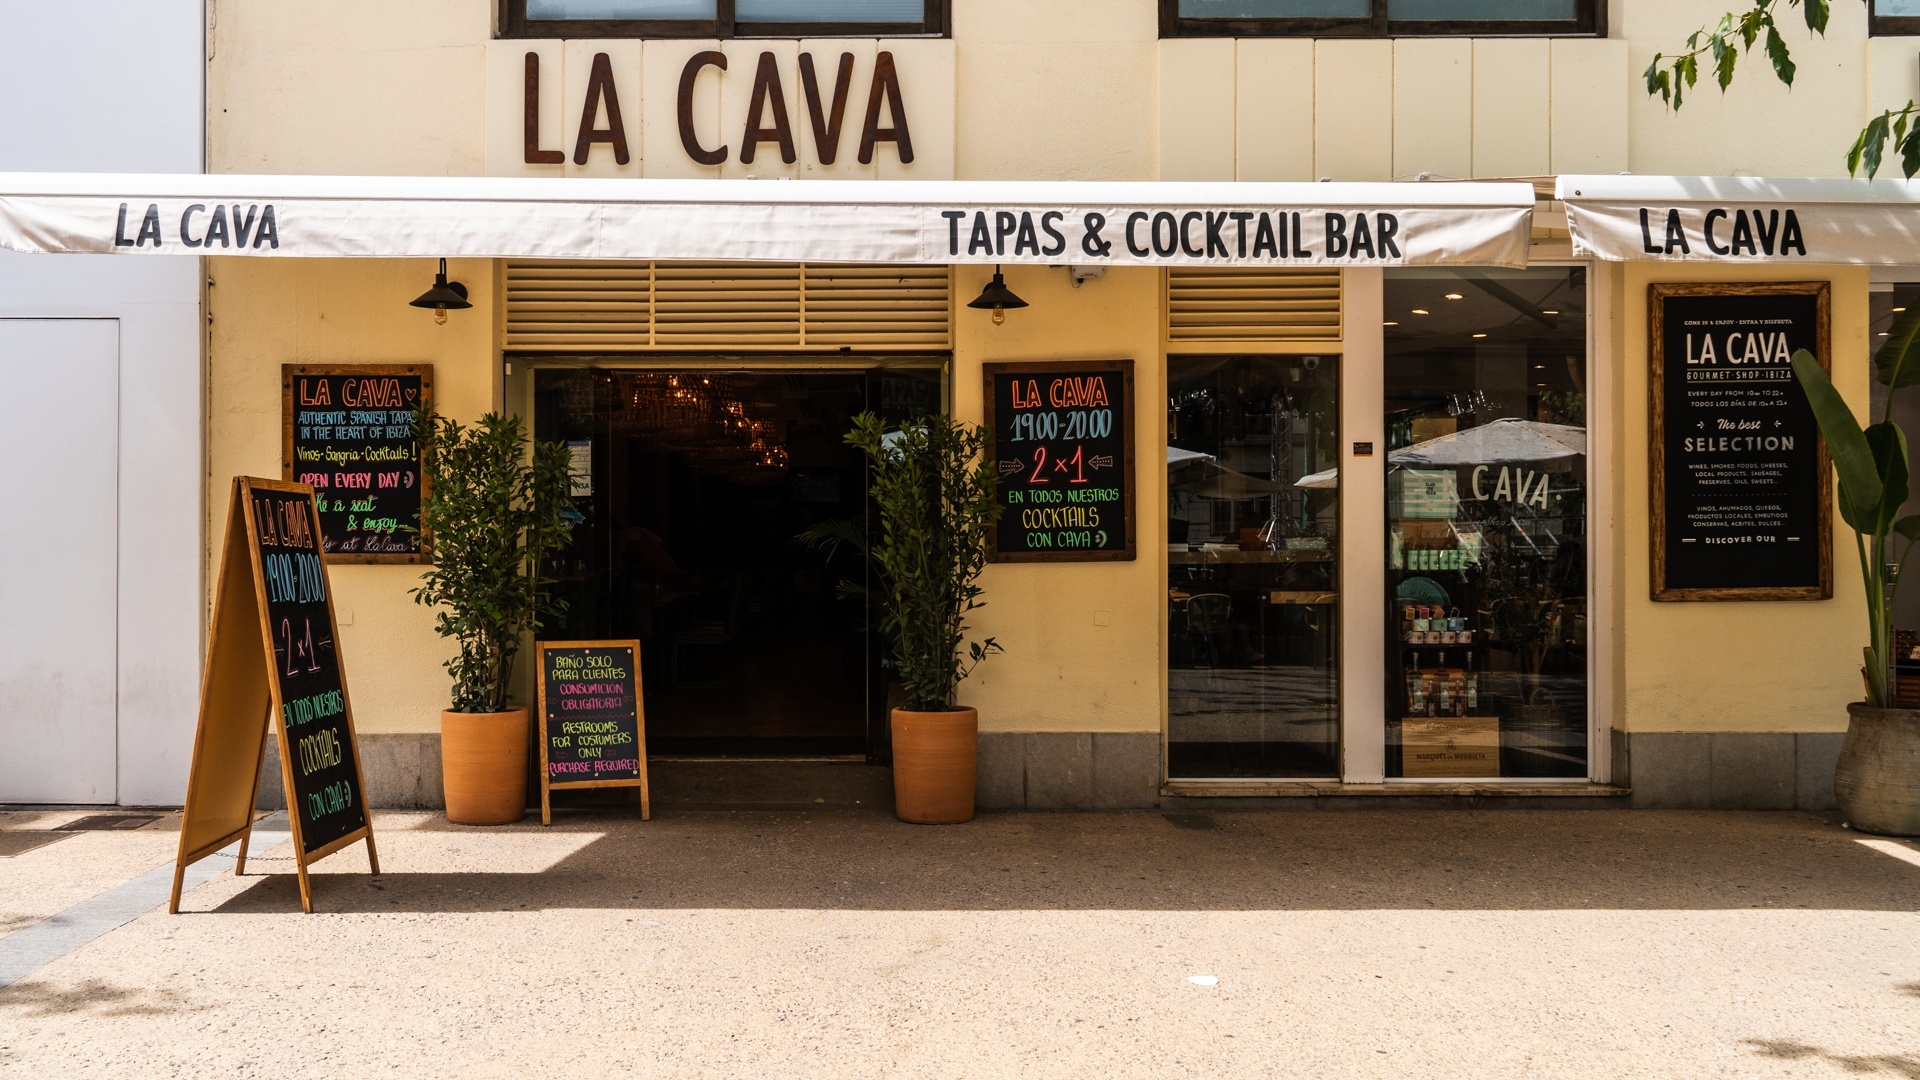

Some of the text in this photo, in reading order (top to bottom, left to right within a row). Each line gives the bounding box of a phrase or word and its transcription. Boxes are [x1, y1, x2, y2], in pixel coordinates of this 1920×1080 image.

[524, 50, 914, 165] LA CAVA
[115, 203, 279, 249] LA CAVA
[1639, 208, 1806, 256] LA CAVA
[941, 210, 1401, 259] TAPAS & COCKTAIL BAR
[1686, 332, 1791, 364] LA CAVA
[300, 378, 403, 407] LA CAVA
[1012, 377, 1108, 408] LA CAVA
[298, 411, 346, 425] AUTHENTIC
[350, 410, 387, 425] SPANISH
[1717, 419, 1761, 430] The best
[301, 426, 411, 440] IN THE HEART OF IBIZA
[1684, 436, 1794, 452] SELECTION
[300, 472, 399, 489] OPEN EVERY DAY
[1472, 465, 1549, 509] CAVA
[333, 500, 345, 512] a
[350, 495, 378, 512] seat
[1008, 488, 1119, 503] EN TODOS NUESTROS
[256, 499, 313, 548] LA CAVA
[347, 515, 357, 531] &
[1022, 506, 1099, 529] COCKTAILS
[341, 537, 360, 550] at
[1027, 530, 1090, 547] CON CAVA
[556, 654, 612, 668] BAÑO SOLO
[552, 668, 626, 680] PARA CLIENTES
[560, 682, 623, 695] CONSUMICIÓN
[283, 690, 343, 728] EN TODOS NUESTROS
[562, 697, 622, 710] OBLIGATORIA
[562, 721, 618, 734] RESTROOMS
[552, 732, 631, 748] FOR COSTUMERS
[300, 728, 341, 776] COCKTAILS
[578, 748, 602, 758] ONLY
[1417, 752, 1446, 761] MARQUÉS
[550, 759, 639, 773] PURCHASE REQUIRED
[308, 781, 344, 820] CON CAVA
